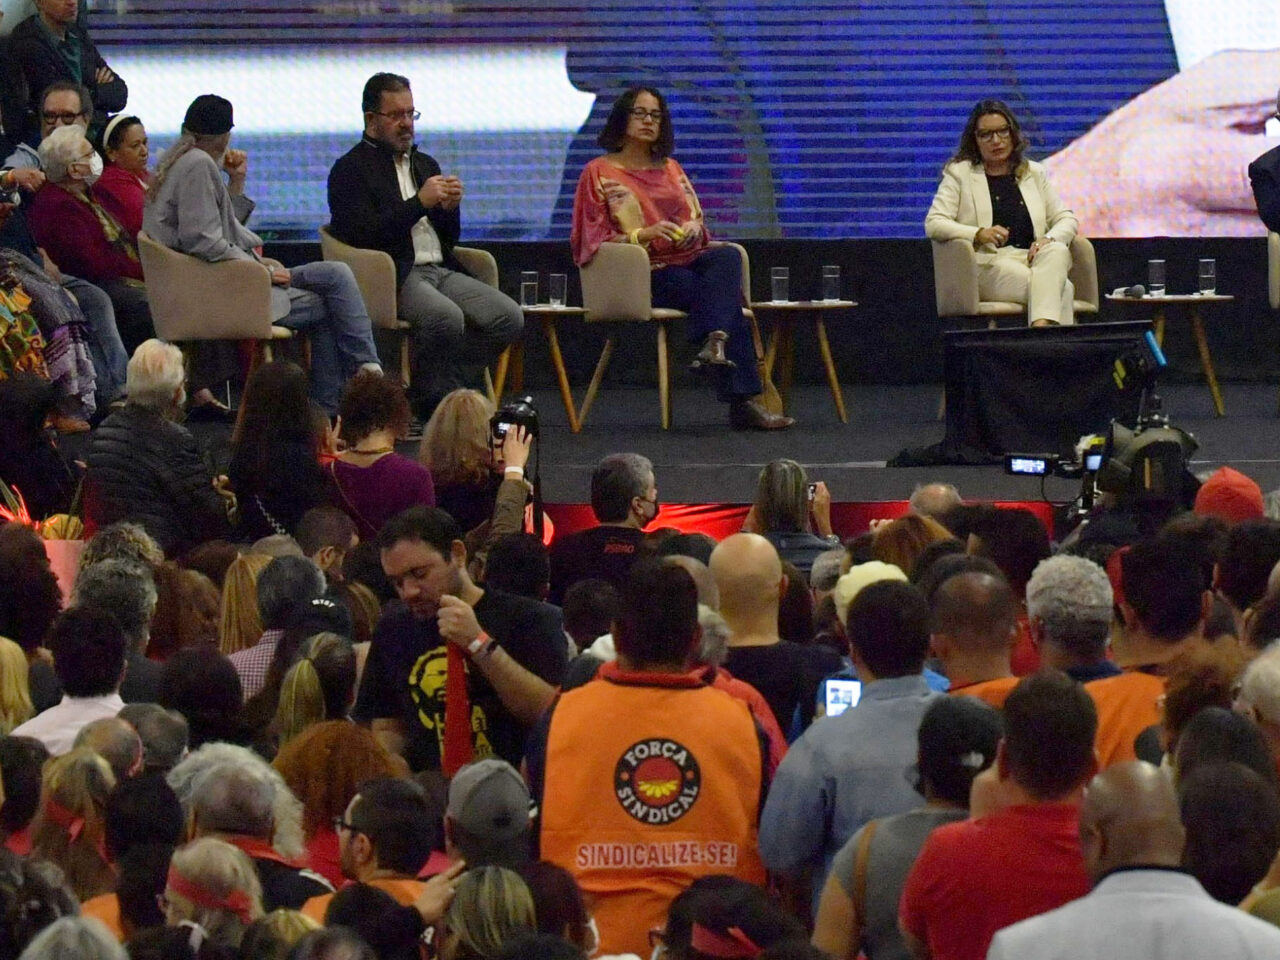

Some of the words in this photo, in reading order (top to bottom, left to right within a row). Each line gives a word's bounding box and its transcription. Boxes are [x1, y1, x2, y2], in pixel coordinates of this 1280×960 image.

[624, 741, 688, 767] FORÇA
[617, 785, 698, 823] SINDICAL
[577, 841, 737, 868] SINDICALIZE-SE!
